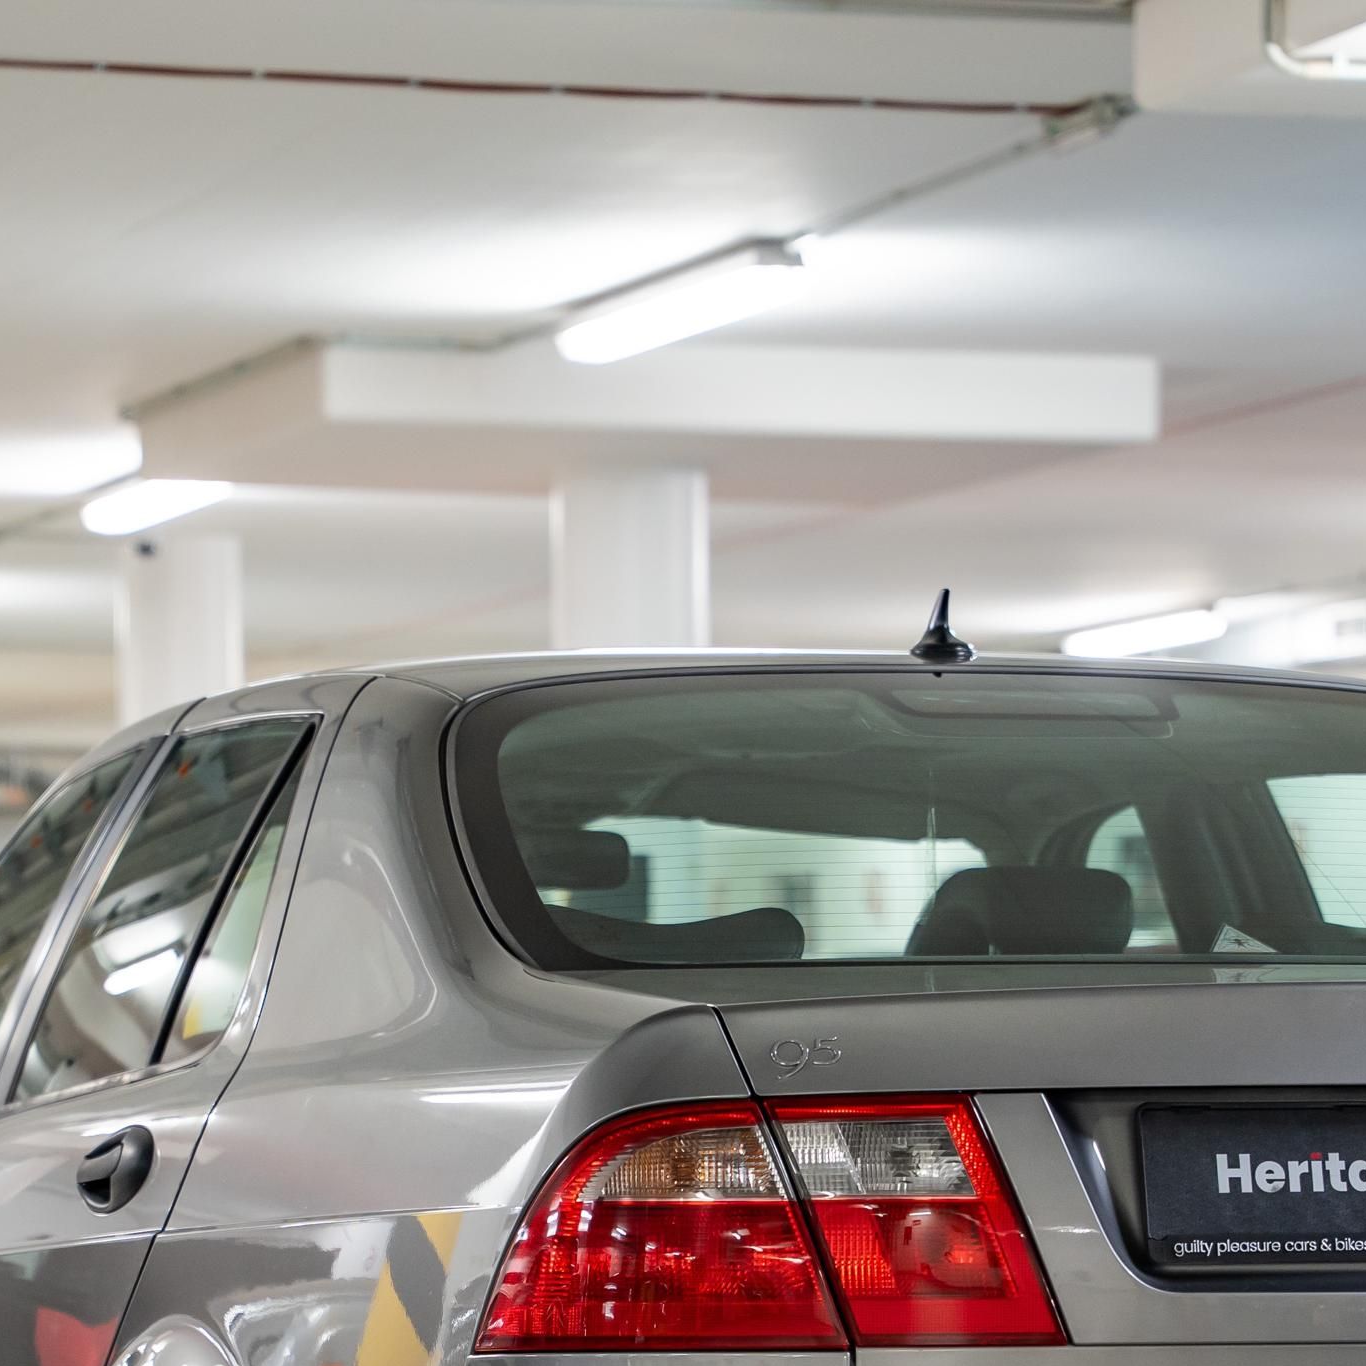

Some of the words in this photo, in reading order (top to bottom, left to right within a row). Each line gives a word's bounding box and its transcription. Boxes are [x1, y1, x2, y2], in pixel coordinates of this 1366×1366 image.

[1173, 1239, 1213, 1257] guilty
[1217, 1239, 1282, 1256] pleasure
[1284, 1240, 1317, 1252] cars
[1320, 1238, 1332, 1252] &
